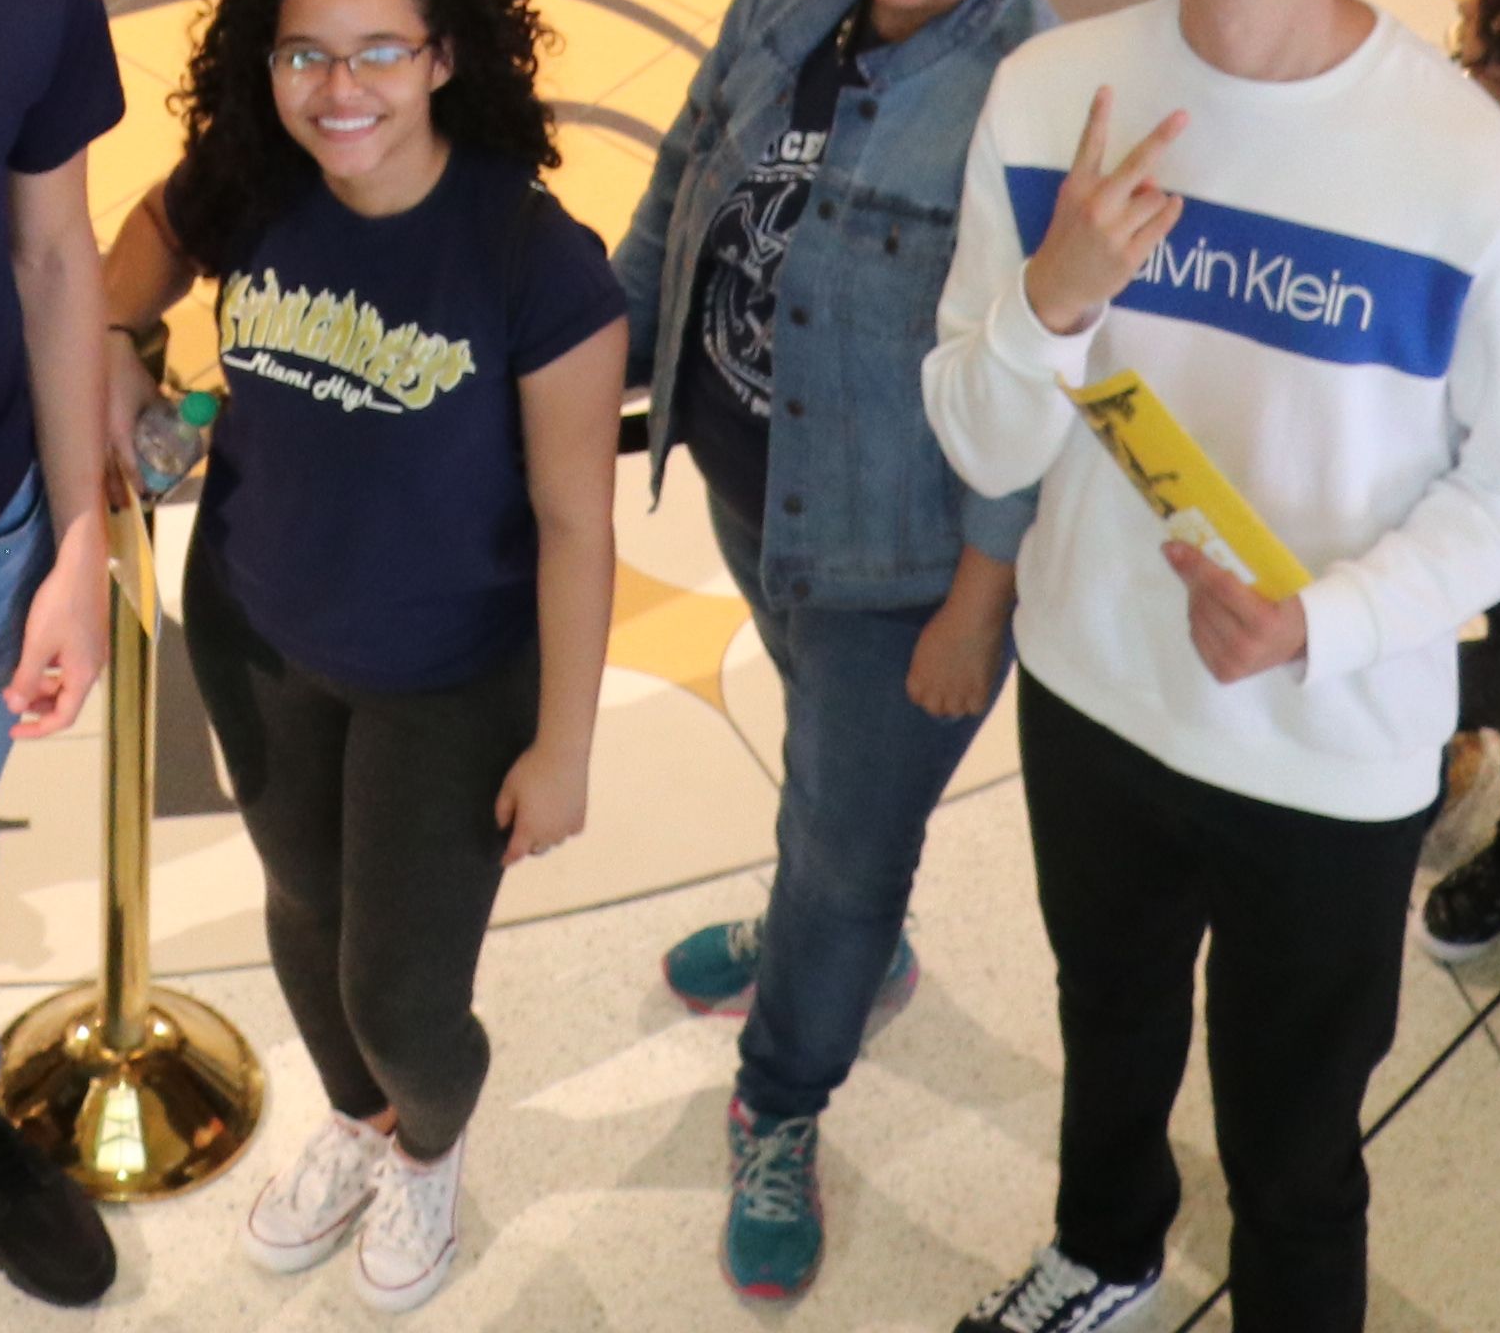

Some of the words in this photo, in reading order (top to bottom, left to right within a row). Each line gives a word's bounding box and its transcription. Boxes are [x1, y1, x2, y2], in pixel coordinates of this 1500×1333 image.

[1132, 236, 1238, 299] alvin
[1242, 246, 1374, 332] Klein
[248, 351, 314, 390] Miami
[312, 374, 375, 413] High
